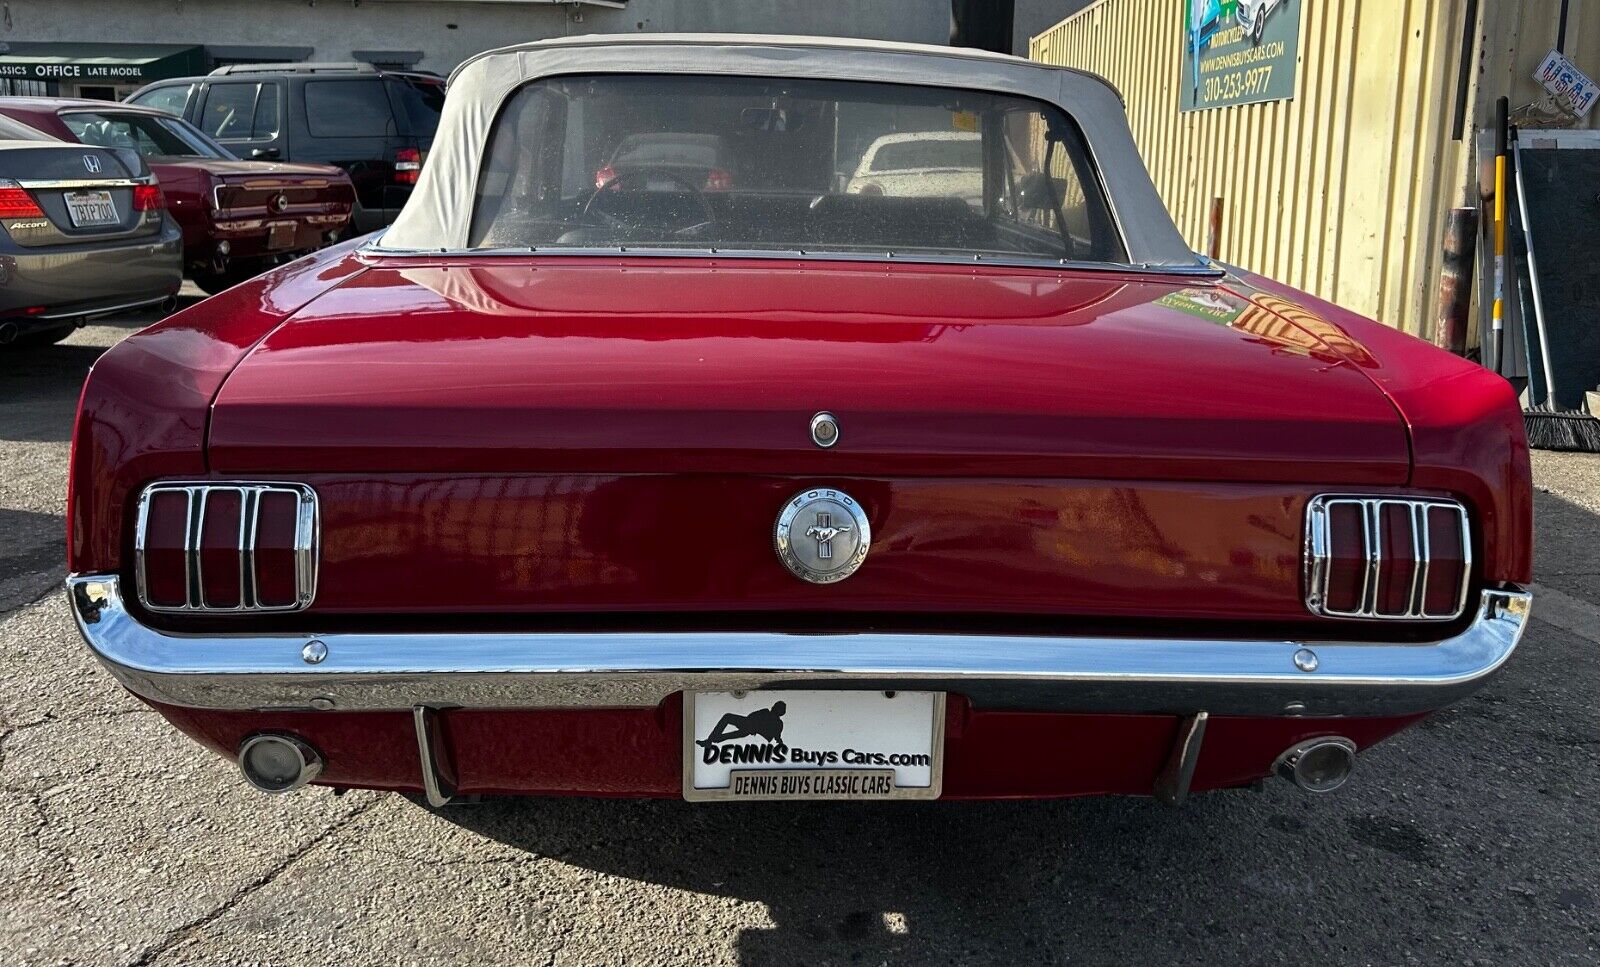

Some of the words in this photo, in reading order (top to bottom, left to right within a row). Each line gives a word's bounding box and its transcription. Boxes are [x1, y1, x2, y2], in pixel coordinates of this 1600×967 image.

[1200, 41, 1284, 74] WWW.DENNISBUYSCARS.COM
[35, 65, 81, 77] OFFICE
[87, 67, 108, 77] LATE
[110, 67, 142, 77] MODEL
[1561, 61, 1589, 86] CHEVROLET
[1204, 65, 1273, 102] 310-253-9977
[10, 220, 48, 230] Accord
[793, 490, 854, 508] FORD
[702, 743, 788, 766] DENNIS
[791, 748, 838, 766] Buys
[841, 748, 931, 767] Cars.com
[734, 776, 778, 795] DENNIS
[780, 776, 810, 794] BUYS
[813, 776, 859, 794] CLASSIC
[861, 775, 891, 794] CARS
